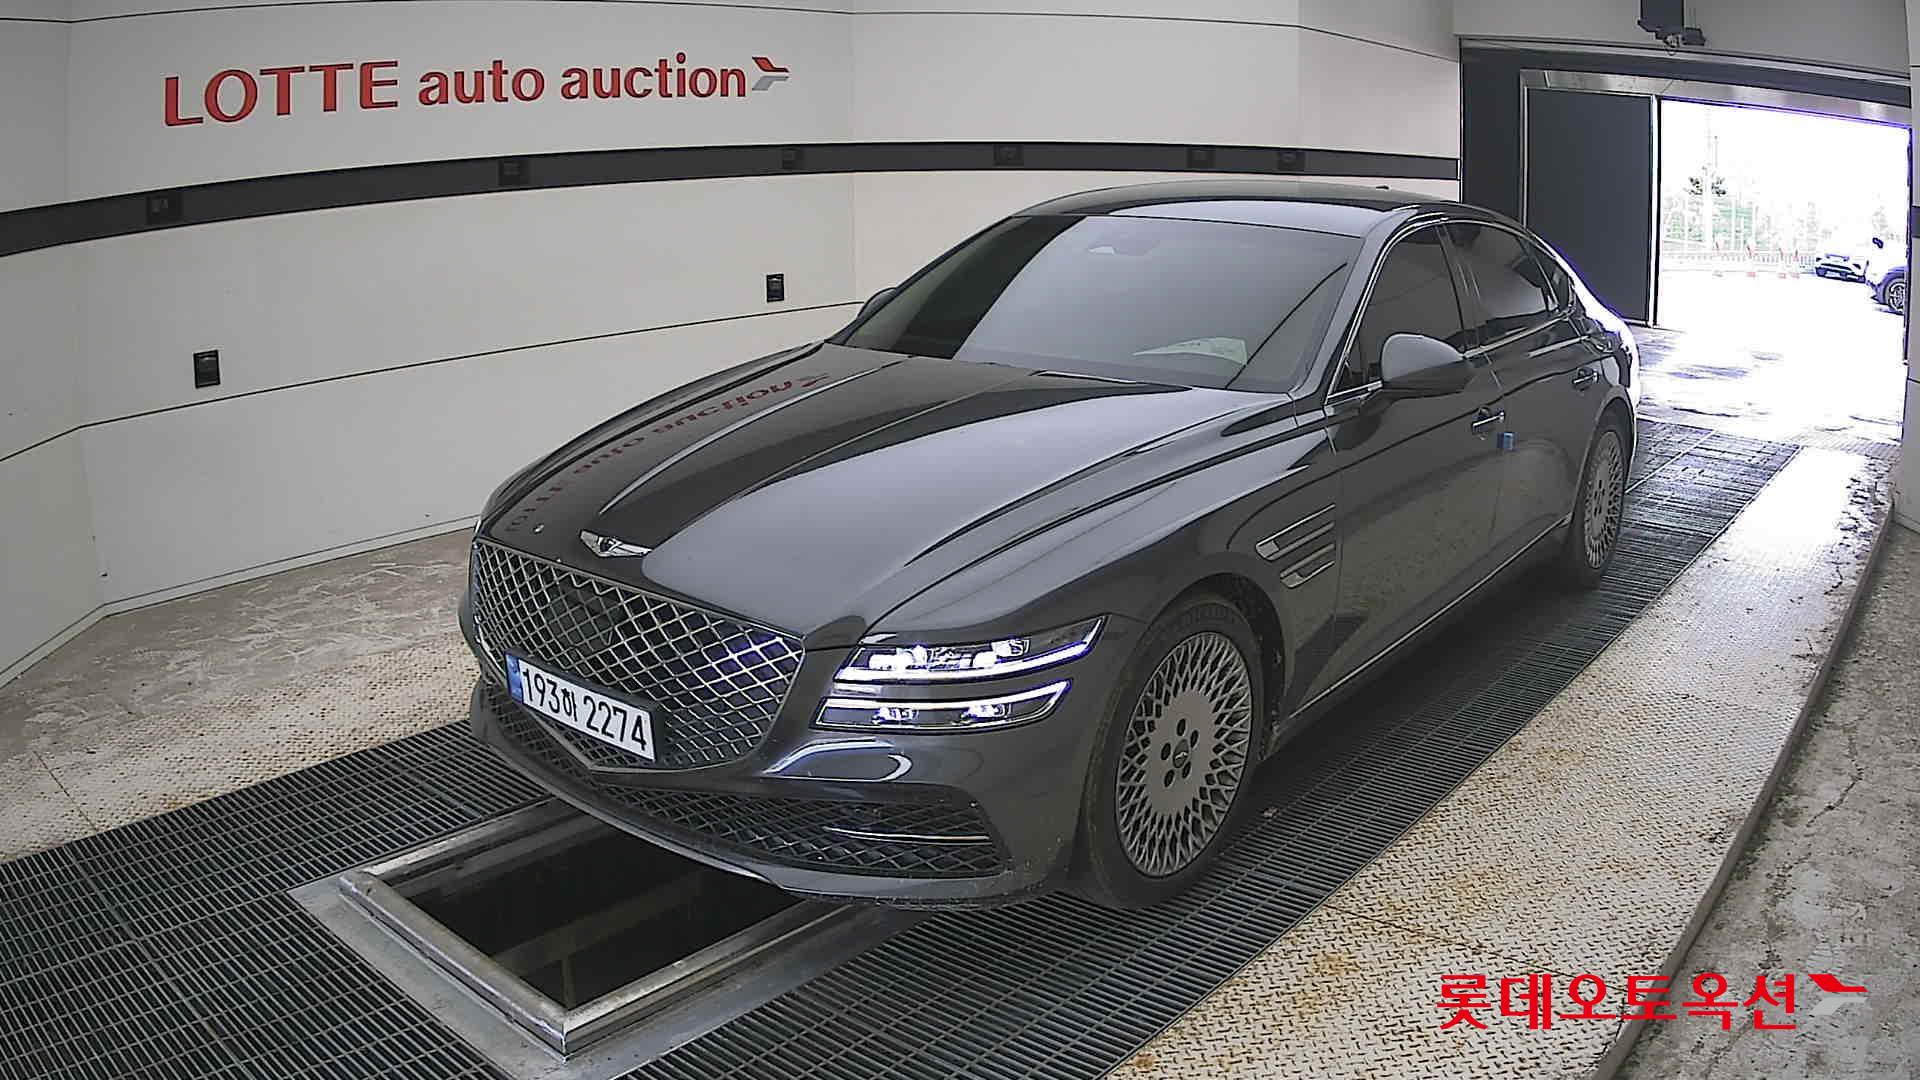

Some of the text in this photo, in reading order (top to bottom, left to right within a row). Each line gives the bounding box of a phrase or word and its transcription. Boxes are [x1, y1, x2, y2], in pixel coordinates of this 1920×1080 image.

[164, 52, 747, 127] LOTTE auto auction
[523, 668, 647, 751] 193하 2274
